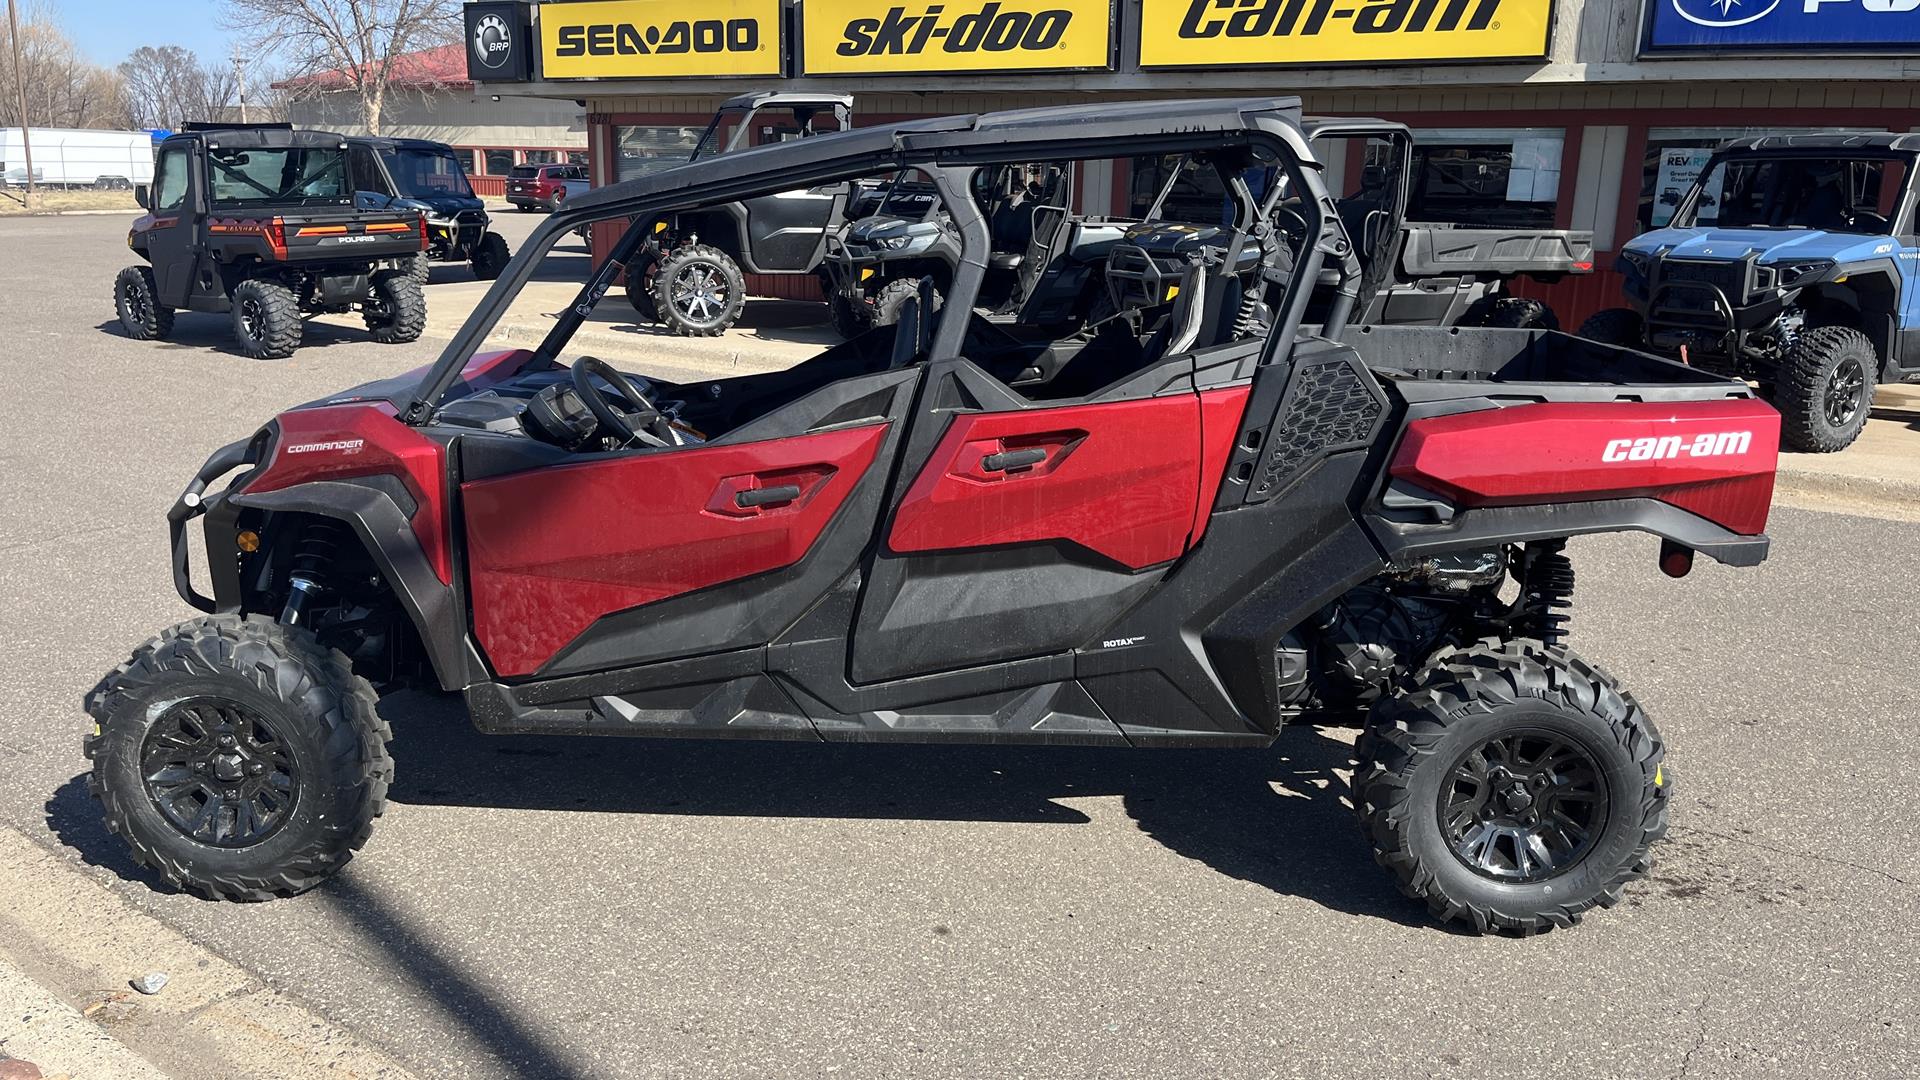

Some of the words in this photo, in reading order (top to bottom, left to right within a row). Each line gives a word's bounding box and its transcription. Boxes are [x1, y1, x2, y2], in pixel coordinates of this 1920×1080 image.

[489, 41, 509, 52] BRP
[338, 235, 375, 243] POLARIS
[288, 440, 364, 454] COMMANDER
[1602, 430, 1753, 463] can-am
[1103, 638, 1133, 648] ROTAX
